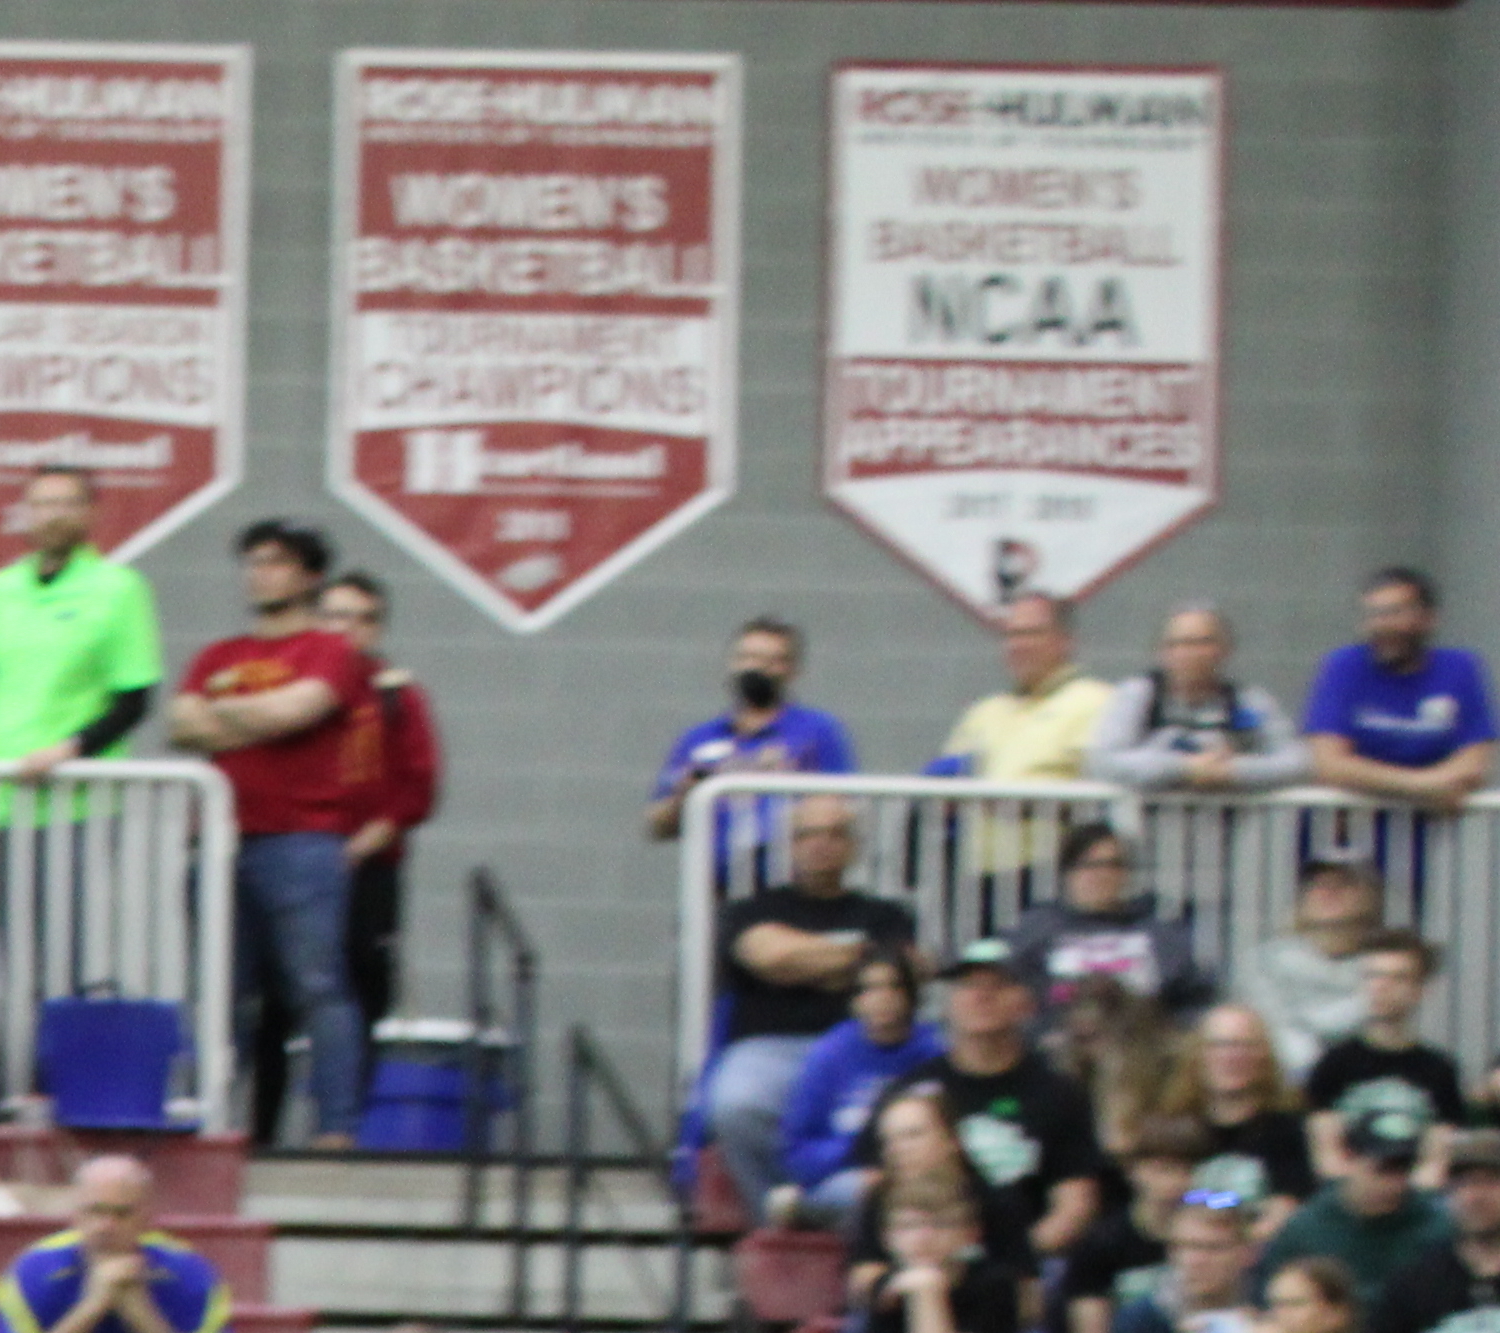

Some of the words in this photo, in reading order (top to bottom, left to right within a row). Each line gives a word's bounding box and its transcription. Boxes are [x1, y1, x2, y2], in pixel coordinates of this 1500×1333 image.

[397, 174, 664, 230] WOMEN'S
[916, 167, 1138, 210] WOMEN'S
[357, 237, 717, 297] BASKETBALL
[872, 222, 1179, 265] BASKETBALL
[910, 275, 1135, 346] NCAA
[393, 318, 678, 356] TOURNAMENT
[366, 361, 699, 417] CHAMPIONS
[852, 366, 1197, 415] TOURNAMENT
[846, 418, 1196, 467] APPEARANCES
